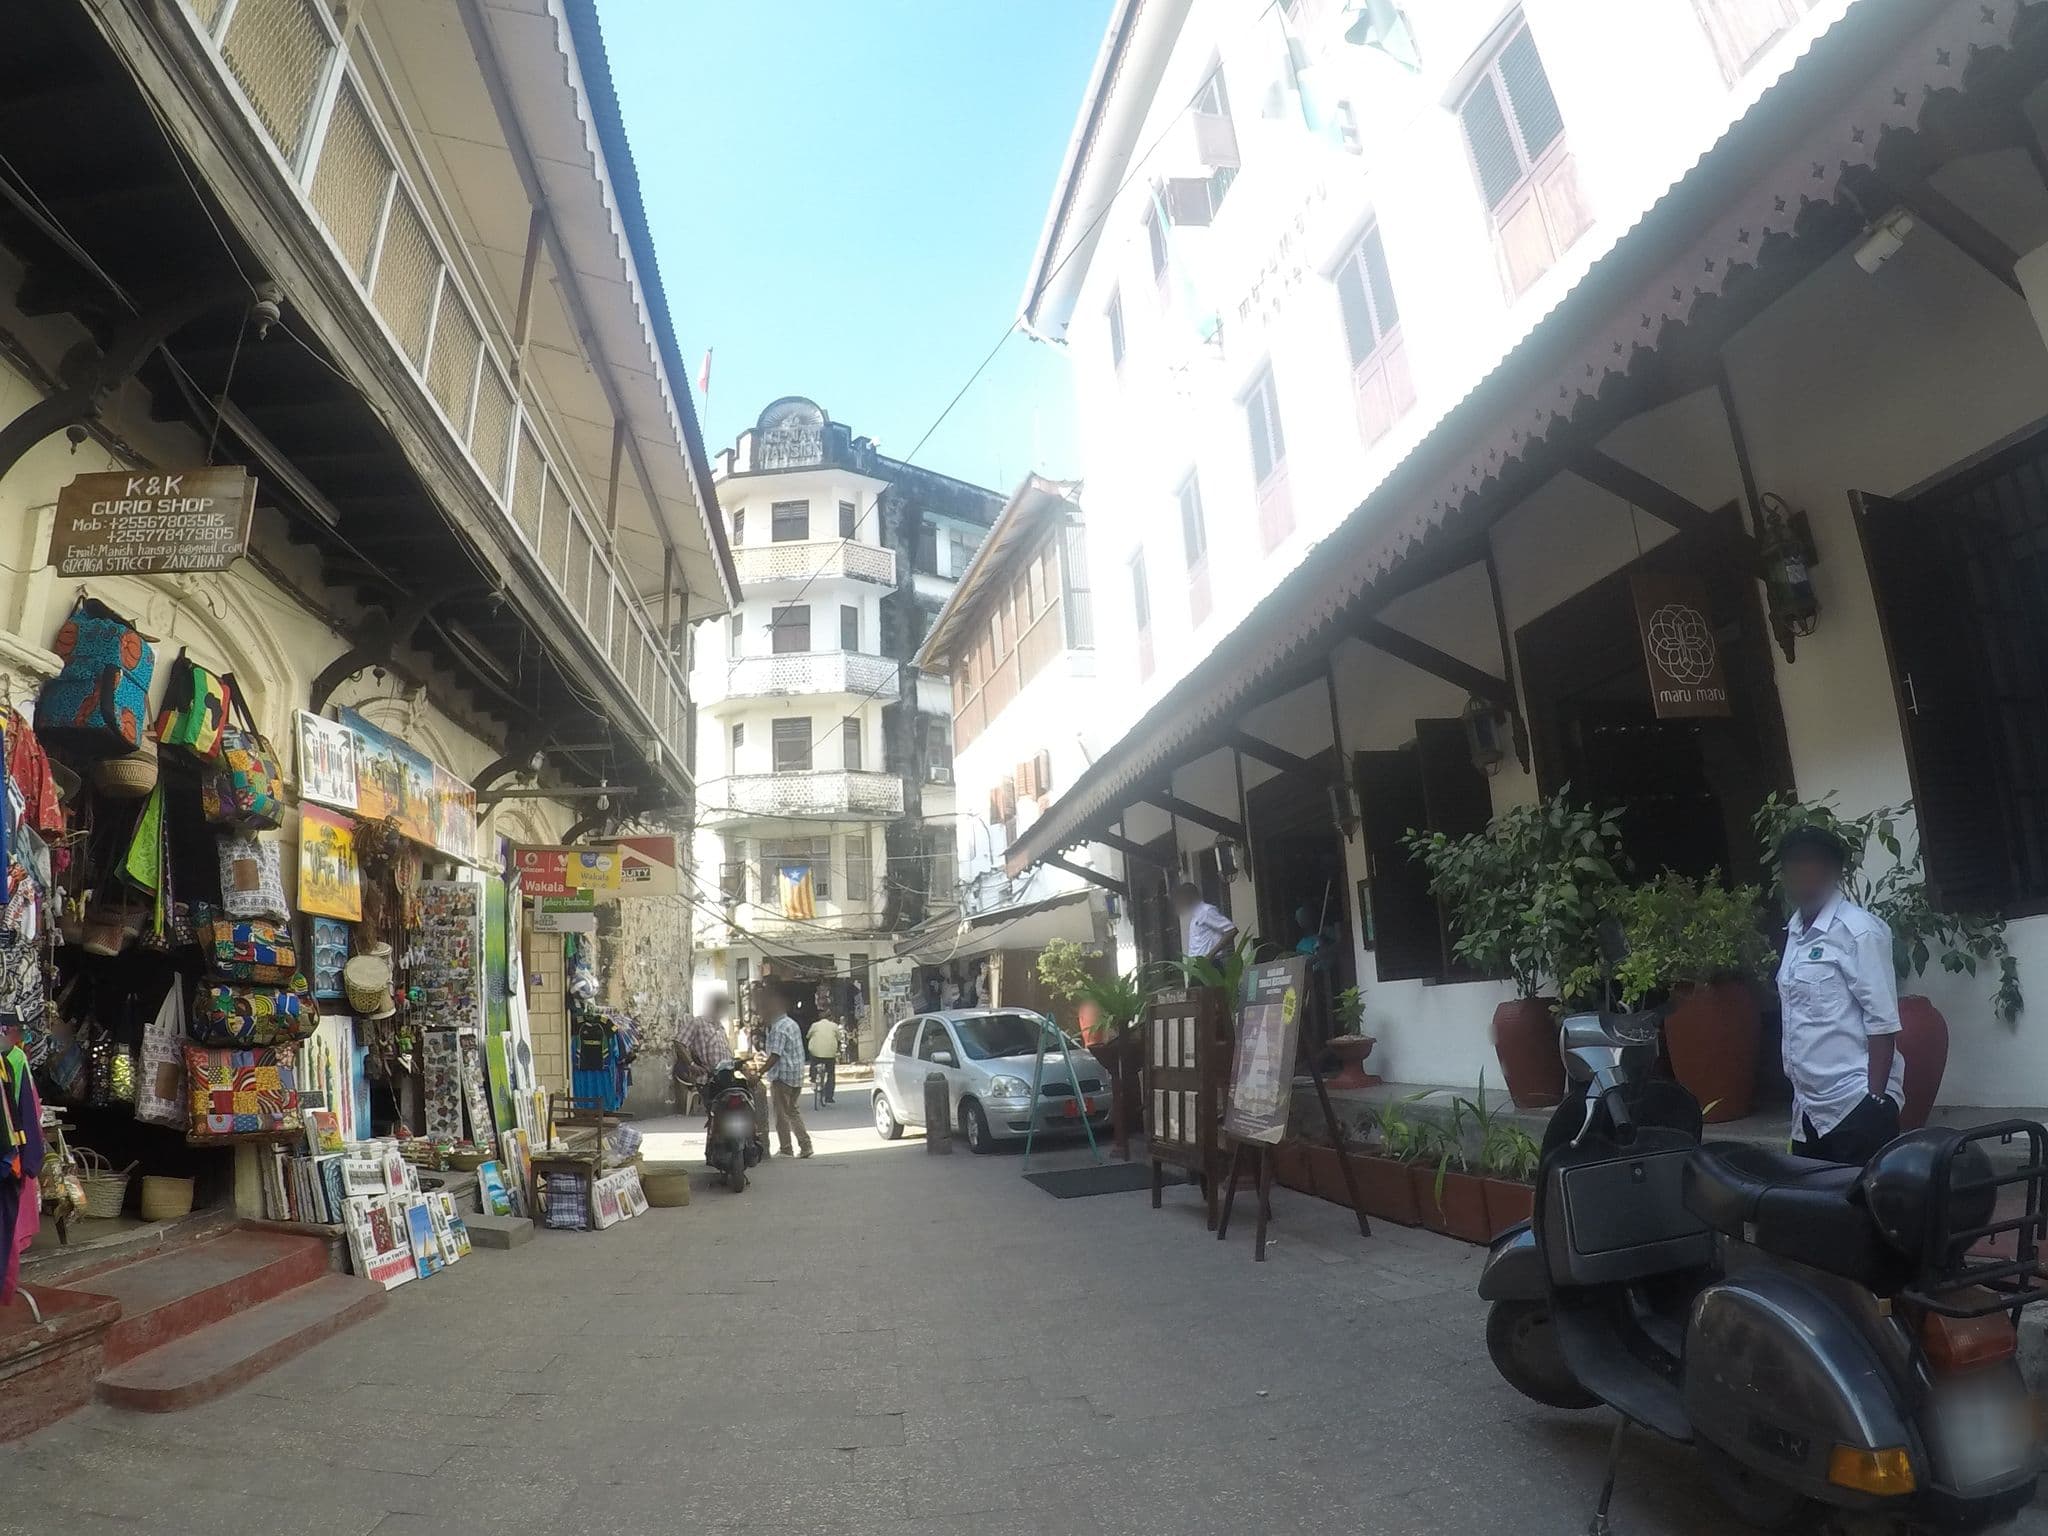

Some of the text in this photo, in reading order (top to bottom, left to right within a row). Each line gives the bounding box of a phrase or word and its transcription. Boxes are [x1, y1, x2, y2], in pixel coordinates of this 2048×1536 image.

[91, 498, 214, 516] CURIO SHOP
[161, 554, 225, 570] ZANZIBAR
[1660, 688, 1725, 702] maru maru
[621, 868, 649, 877] QUITY
[525, 881, 565, 893] Wakala
